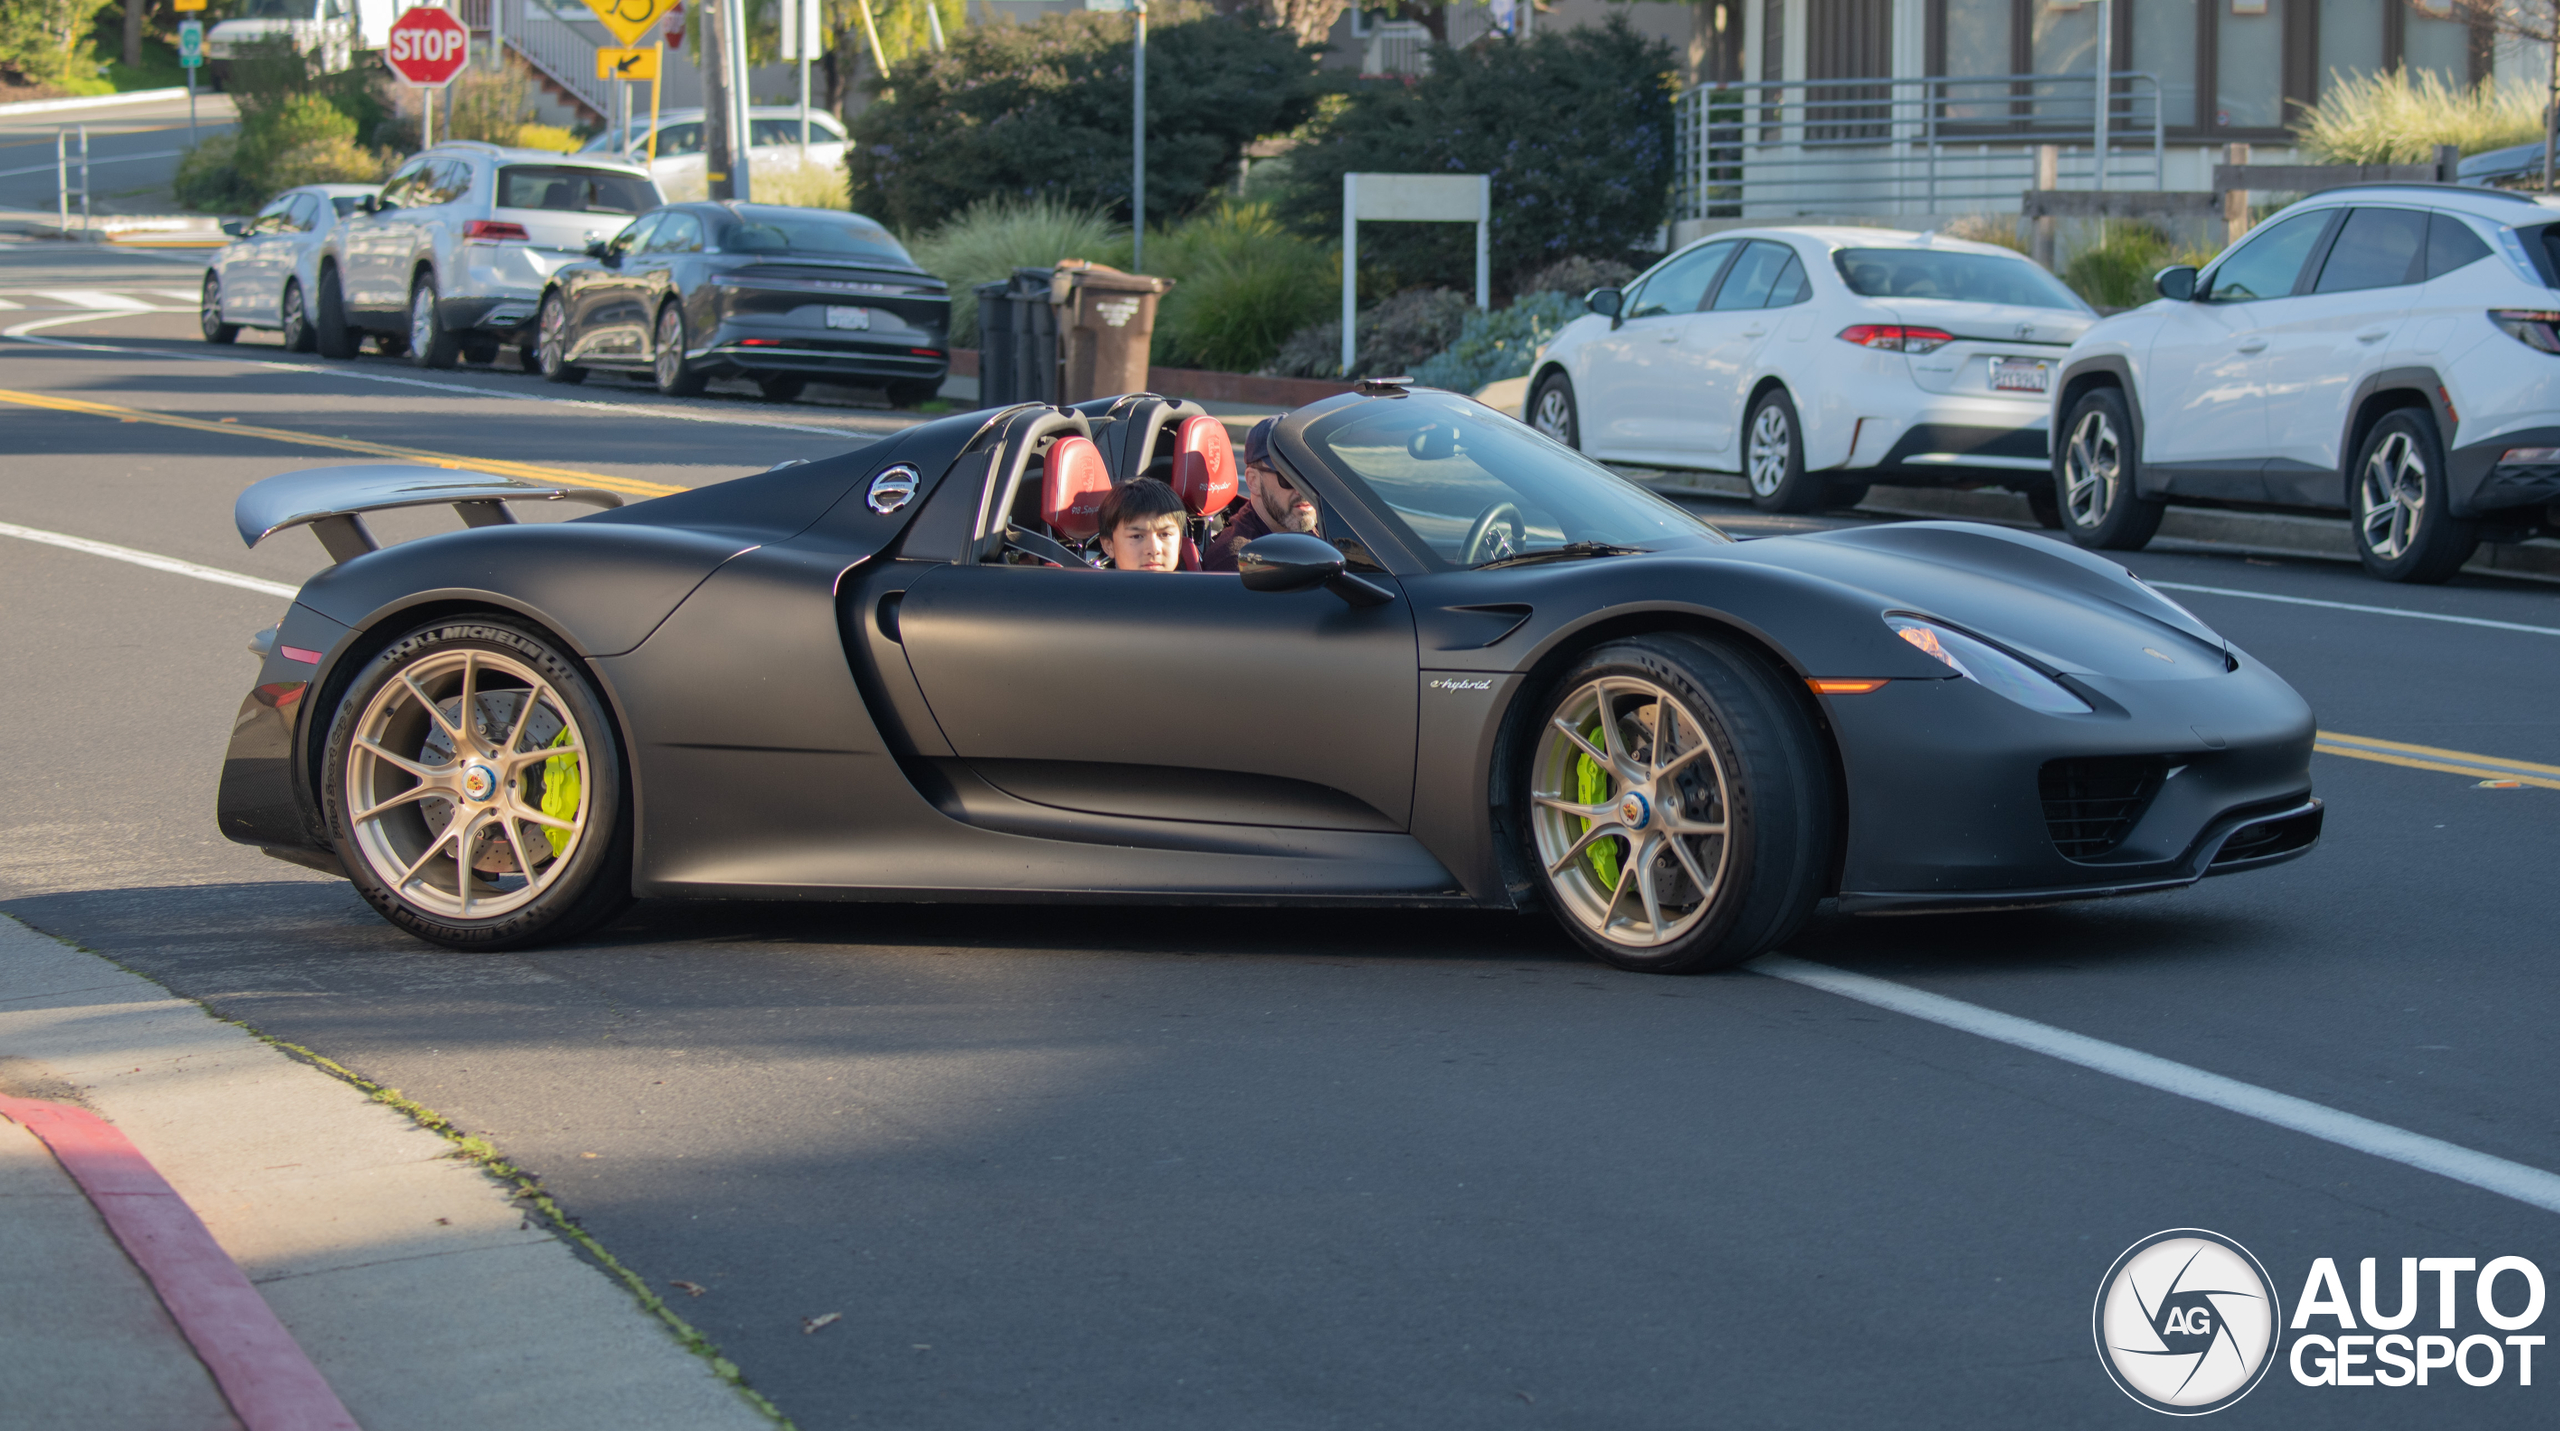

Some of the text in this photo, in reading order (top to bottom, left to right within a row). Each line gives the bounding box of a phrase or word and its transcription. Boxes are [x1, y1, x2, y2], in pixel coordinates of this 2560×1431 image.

[391, 28, 463, 62] STOP
[1208, 481, 1231, 494] Spyder
[1071, 504, 1101, 516] 918 Spyd
[440, 625, 543, 660] MICHELIN
[343, 698, 354, 716] 2
[331, 715, 347, 746] Cup
[326, 746, 338, 797] Sport
[394, 908, 495, 942] MICHELIN
